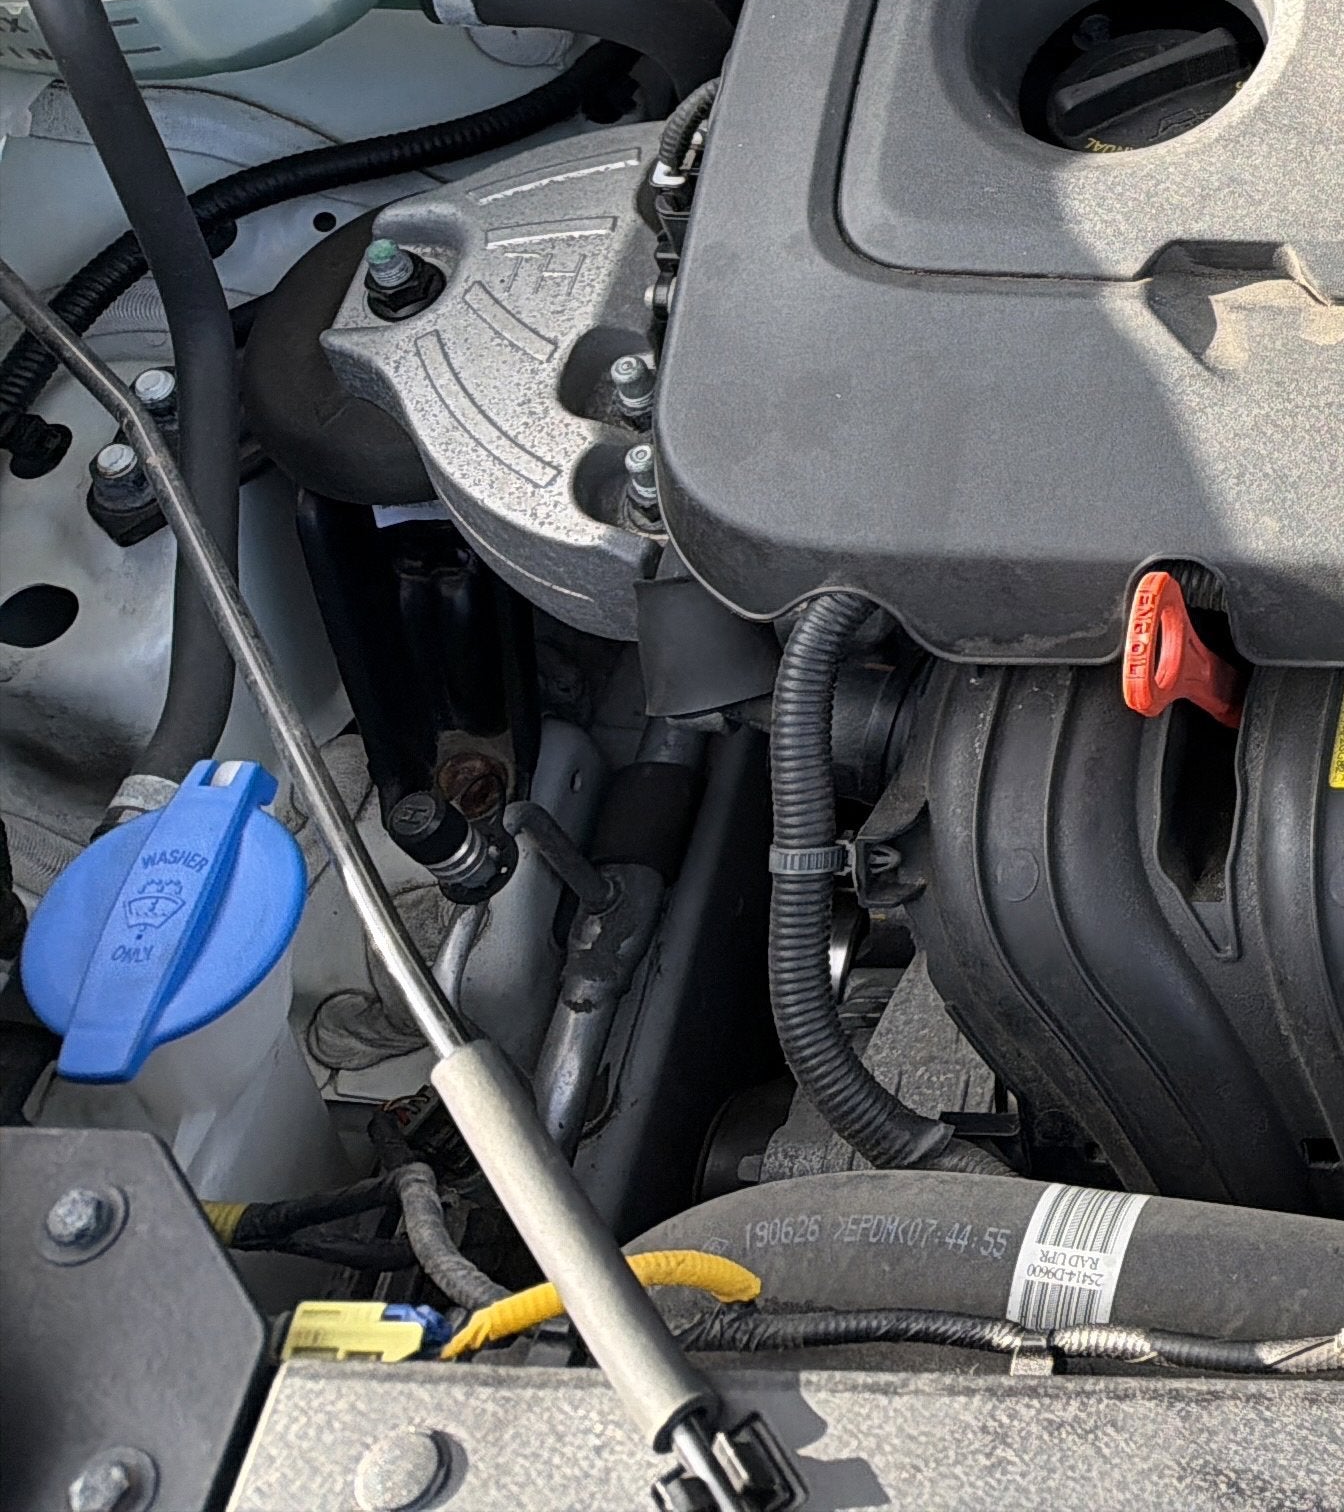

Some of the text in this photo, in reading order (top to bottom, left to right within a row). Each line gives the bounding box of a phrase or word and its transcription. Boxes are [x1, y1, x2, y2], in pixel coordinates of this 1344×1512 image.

[1129, 642, 1149, 676] OIL
[142, 849, 209, 873] WASHER
[111, 945, 154, 962] ONLY
[744, 1214, 822, 1249] 190626
[1039, 1248, 1100, 1270] RAD UPR
